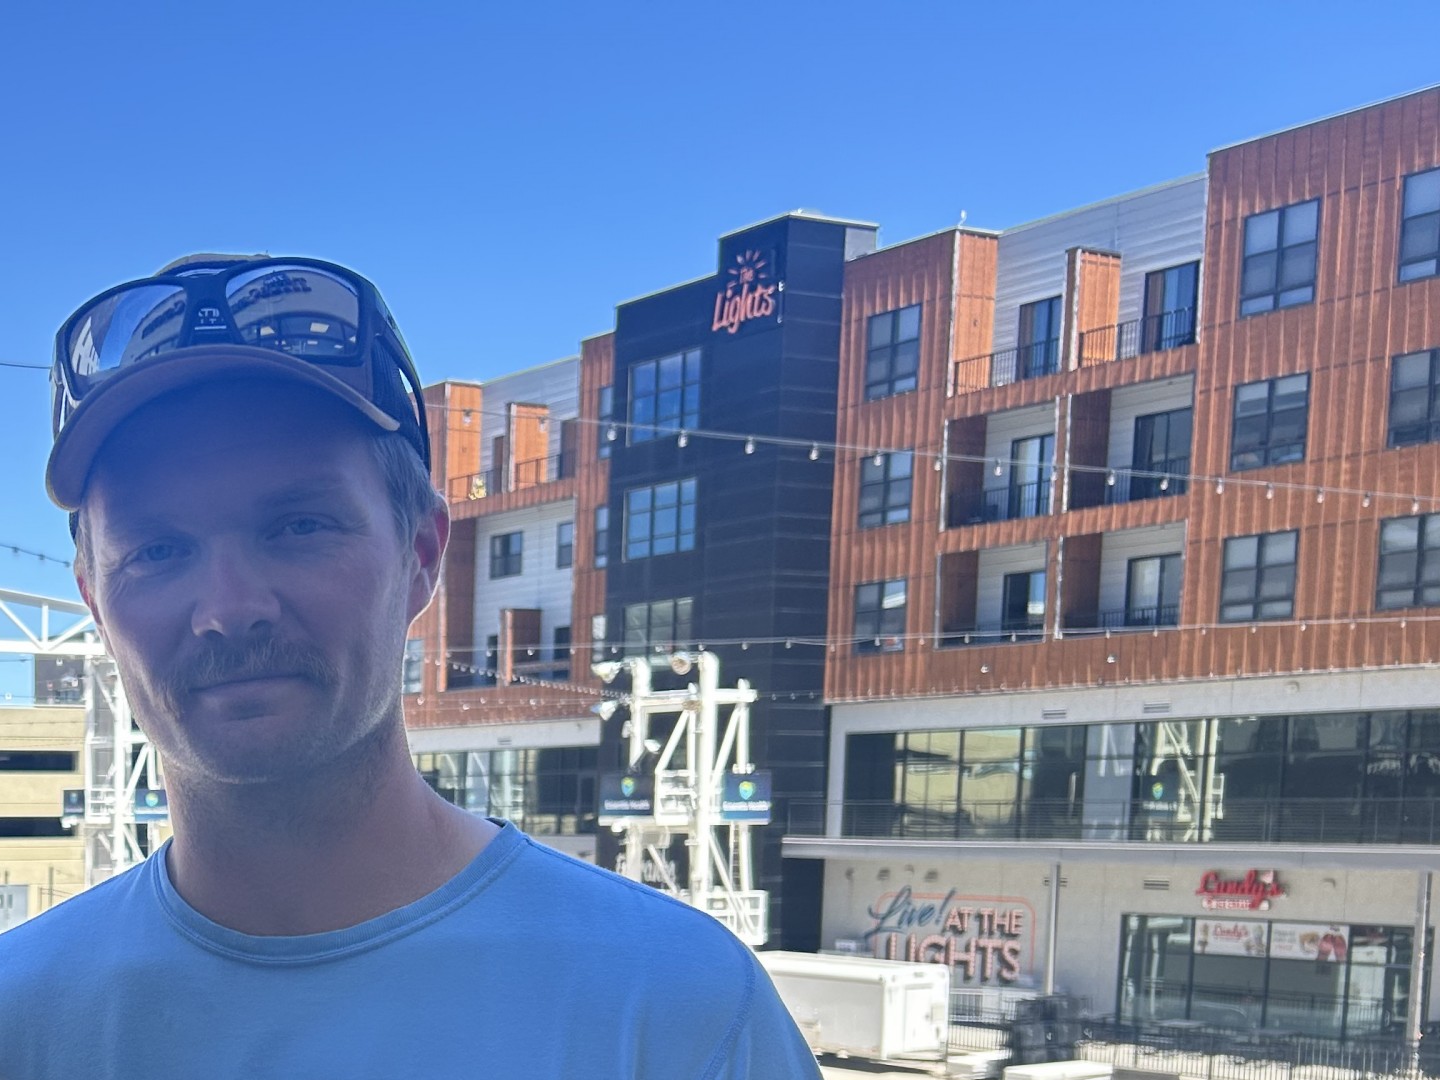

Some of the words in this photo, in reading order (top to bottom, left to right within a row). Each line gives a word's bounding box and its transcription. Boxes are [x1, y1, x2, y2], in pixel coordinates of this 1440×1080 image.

[712, 284, 776, 334] Lights
[944, 906, 973, 933] AT
[978, 907, 1024, 936] THE
